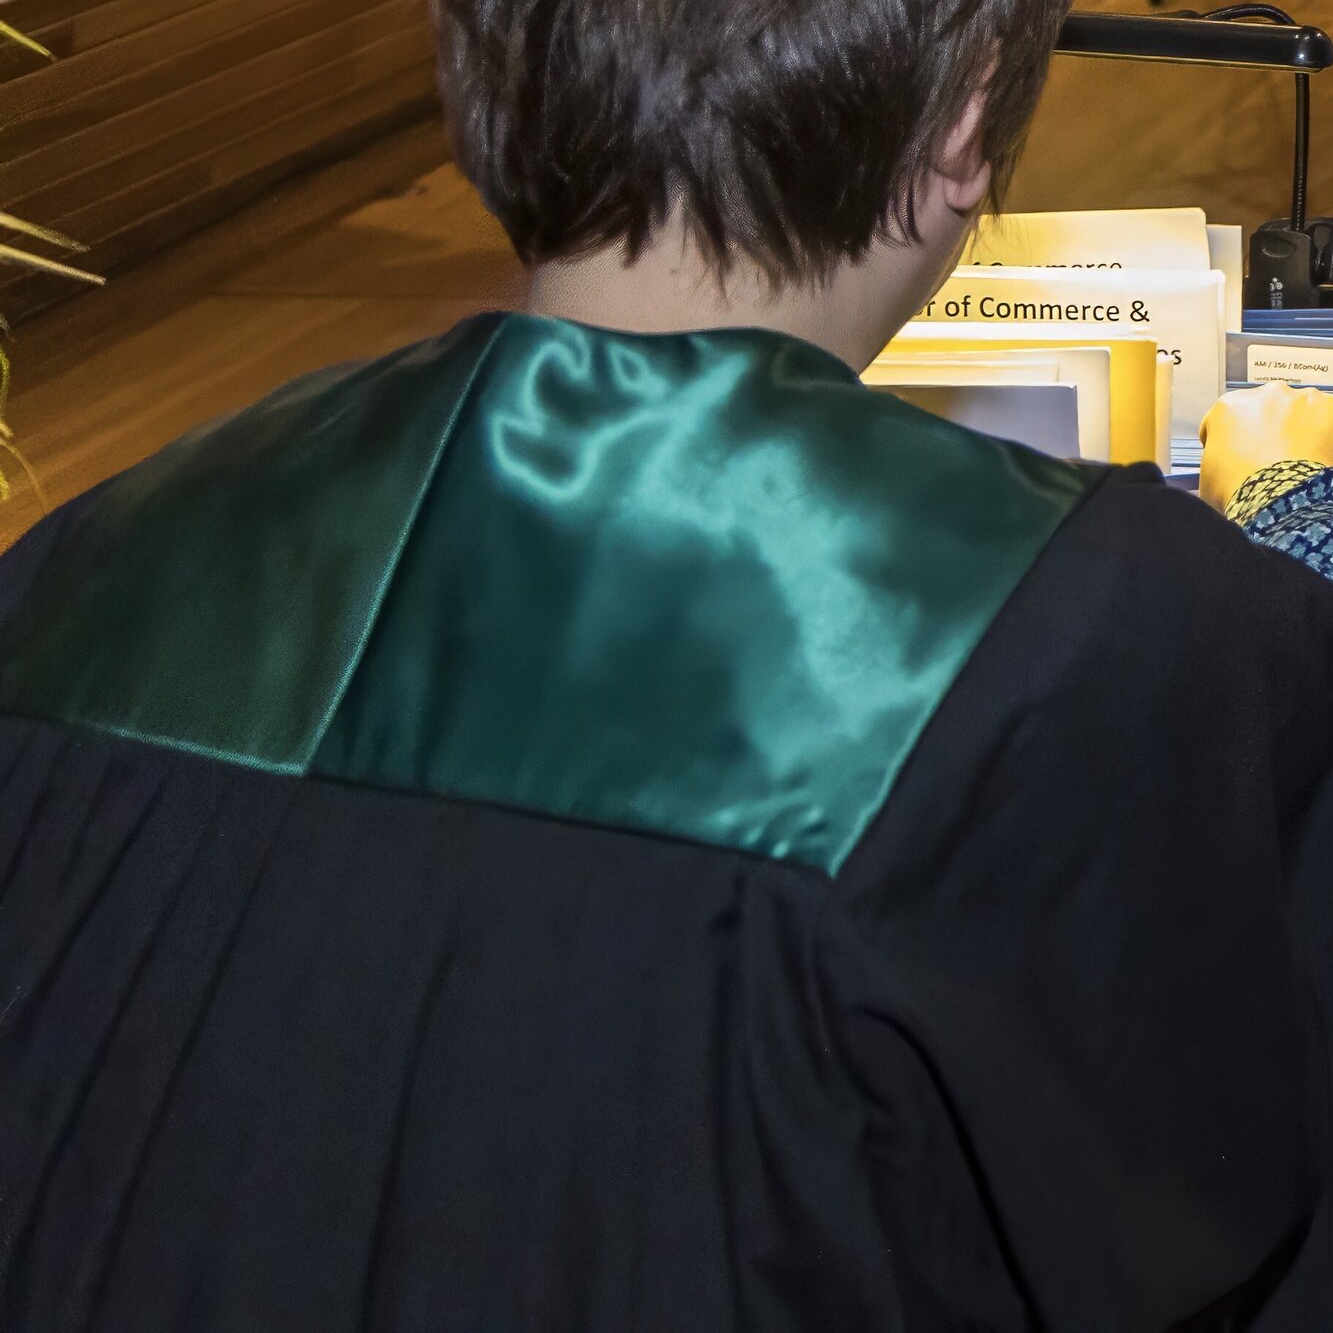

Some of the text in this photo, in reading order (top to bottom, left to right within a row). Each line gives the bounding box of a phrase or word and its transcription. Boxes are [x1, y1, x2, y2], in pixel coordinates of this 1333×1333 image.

[944, 295, 971, 317] of
[979, 296, 1120, 322] Commerce
[1129, 300, 1150, 322] &
